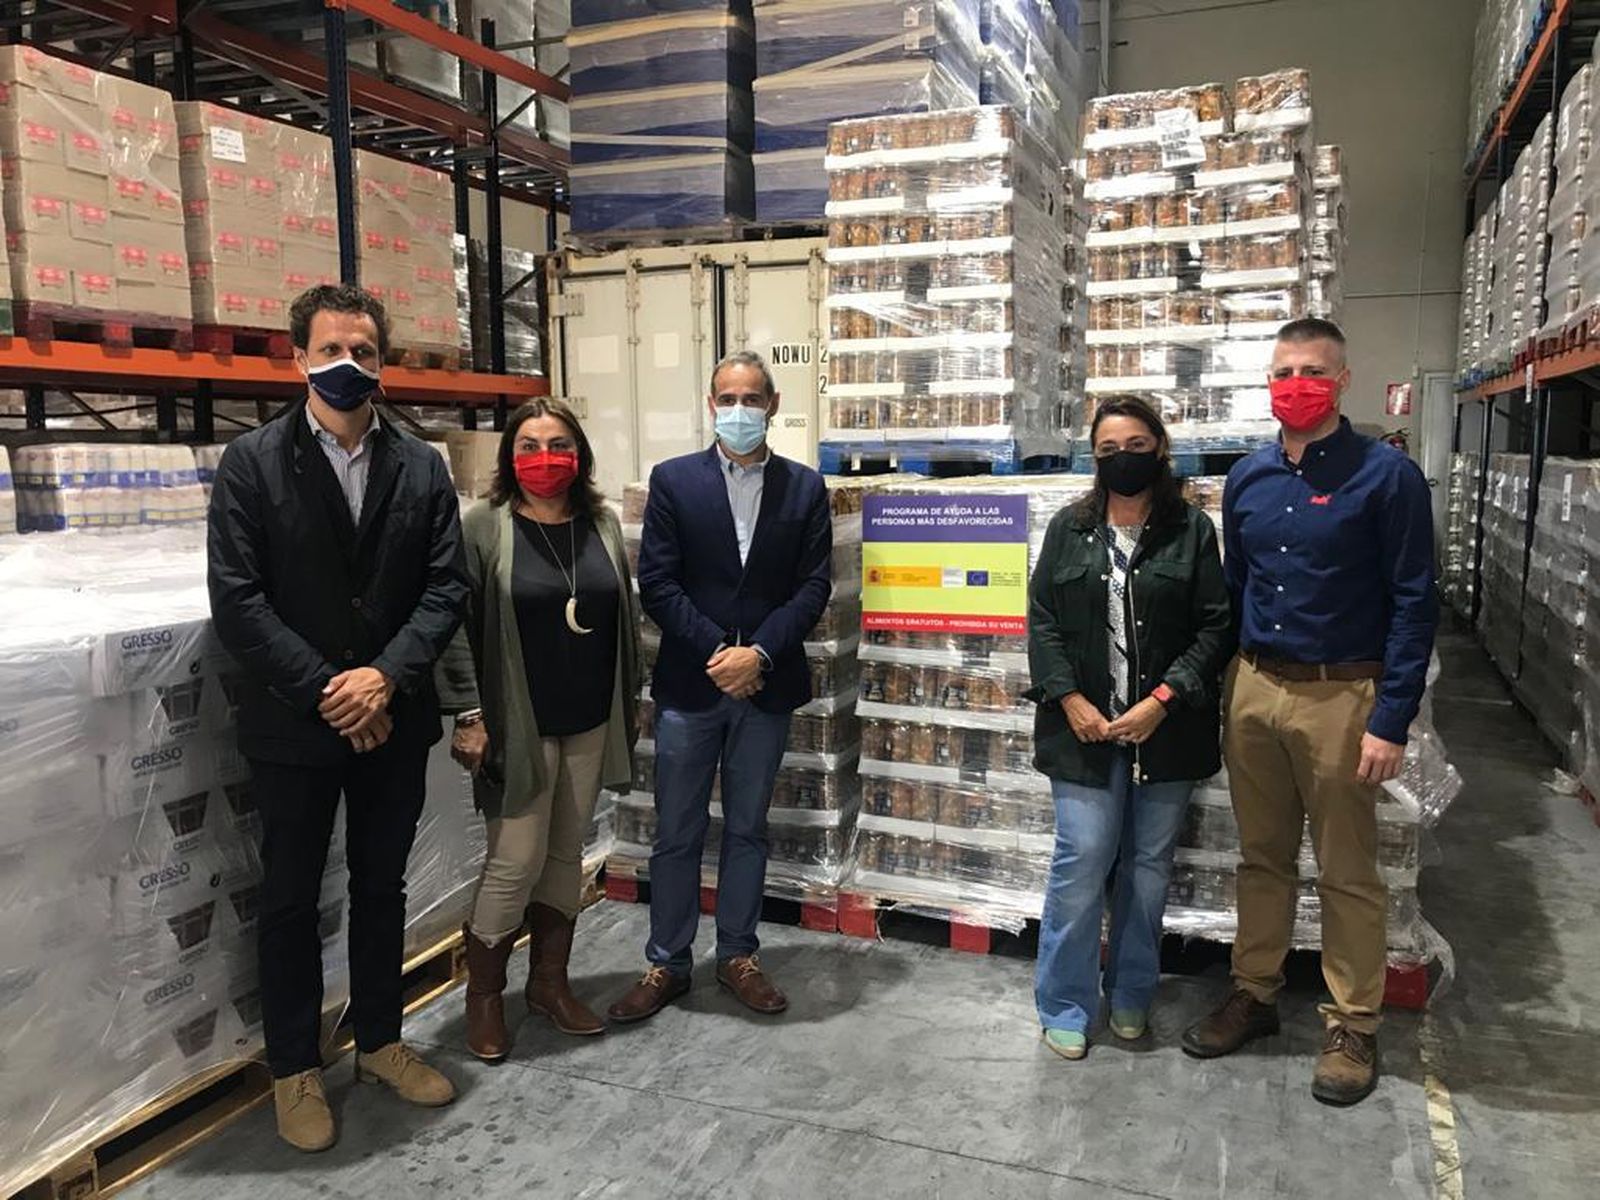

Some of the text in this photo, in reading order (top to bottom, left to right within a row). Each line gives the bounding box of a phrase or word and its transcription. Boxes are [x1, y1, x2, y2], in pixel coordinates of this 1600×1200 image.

[772, 345, 828, 364] NOWU 2
[819, 375, 828, 394] 2
[882, 507, 929, 516] PROGRAMA
[930, 507, 941, 516] DE
[974, 507, 981, 516] A
[982, 506, 1000, 515] LAS
[871, 517, 916, 526] PERSONAS
[936, 516, 1014, 526] DESFAVORECIDAS
[1000, 622, 1024, 631] VENTA
[121, 629, 173, 650] GRESSO
[131, 747, 183, 770] GRESSO
[139, 862, 191, 890] GRESSO
[143, 973, 195, 1005] GRESSO
